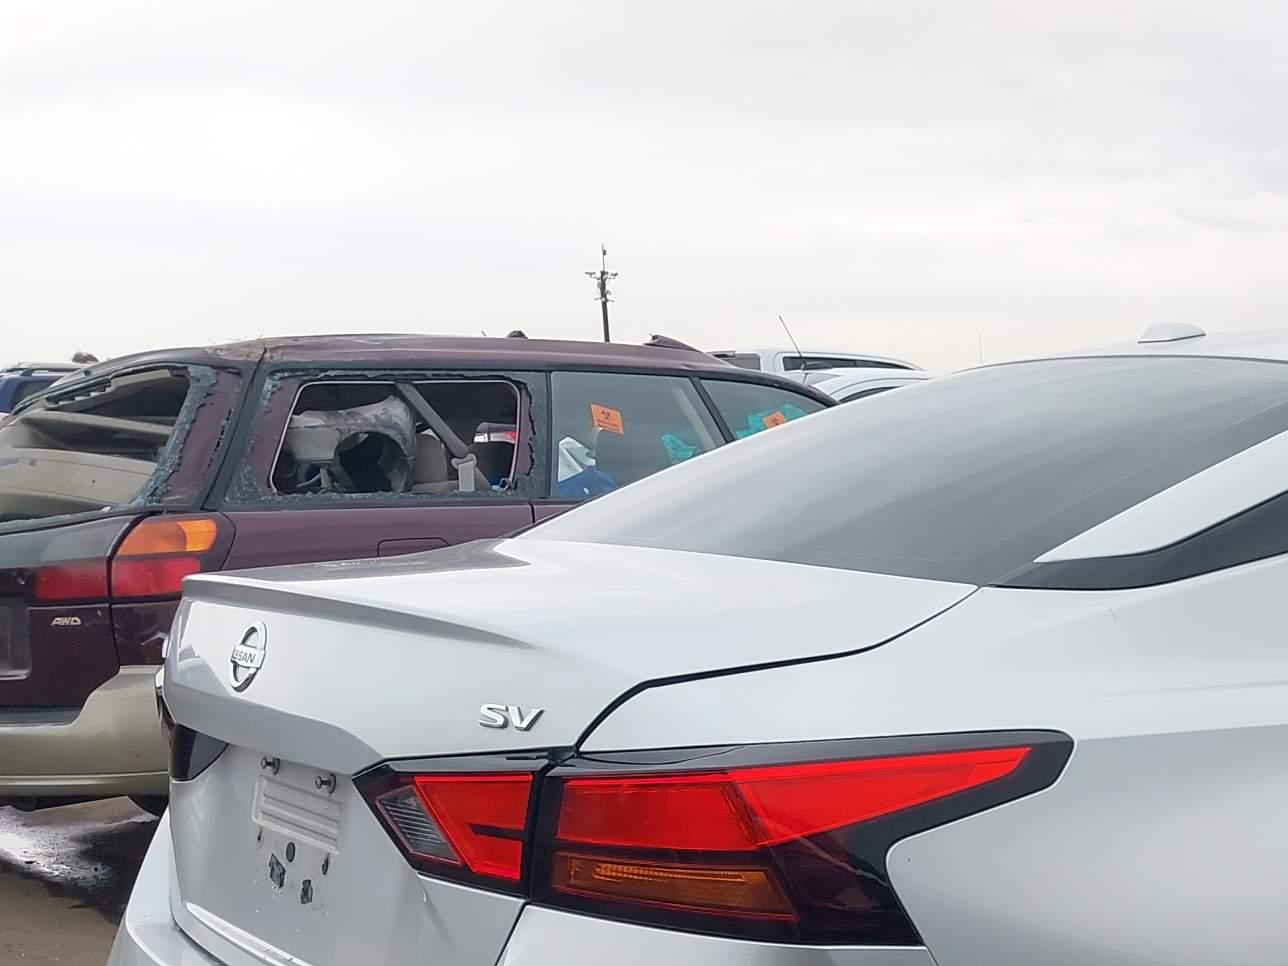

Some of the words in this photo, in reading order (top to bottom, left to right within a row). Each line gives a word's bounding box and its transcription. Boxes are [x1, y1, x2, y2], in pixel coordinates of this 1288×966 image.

[51, 616, 82, 626] AWD
[232, 648, 257, 664] SSAN
[478, 703, 545, 731] SV
